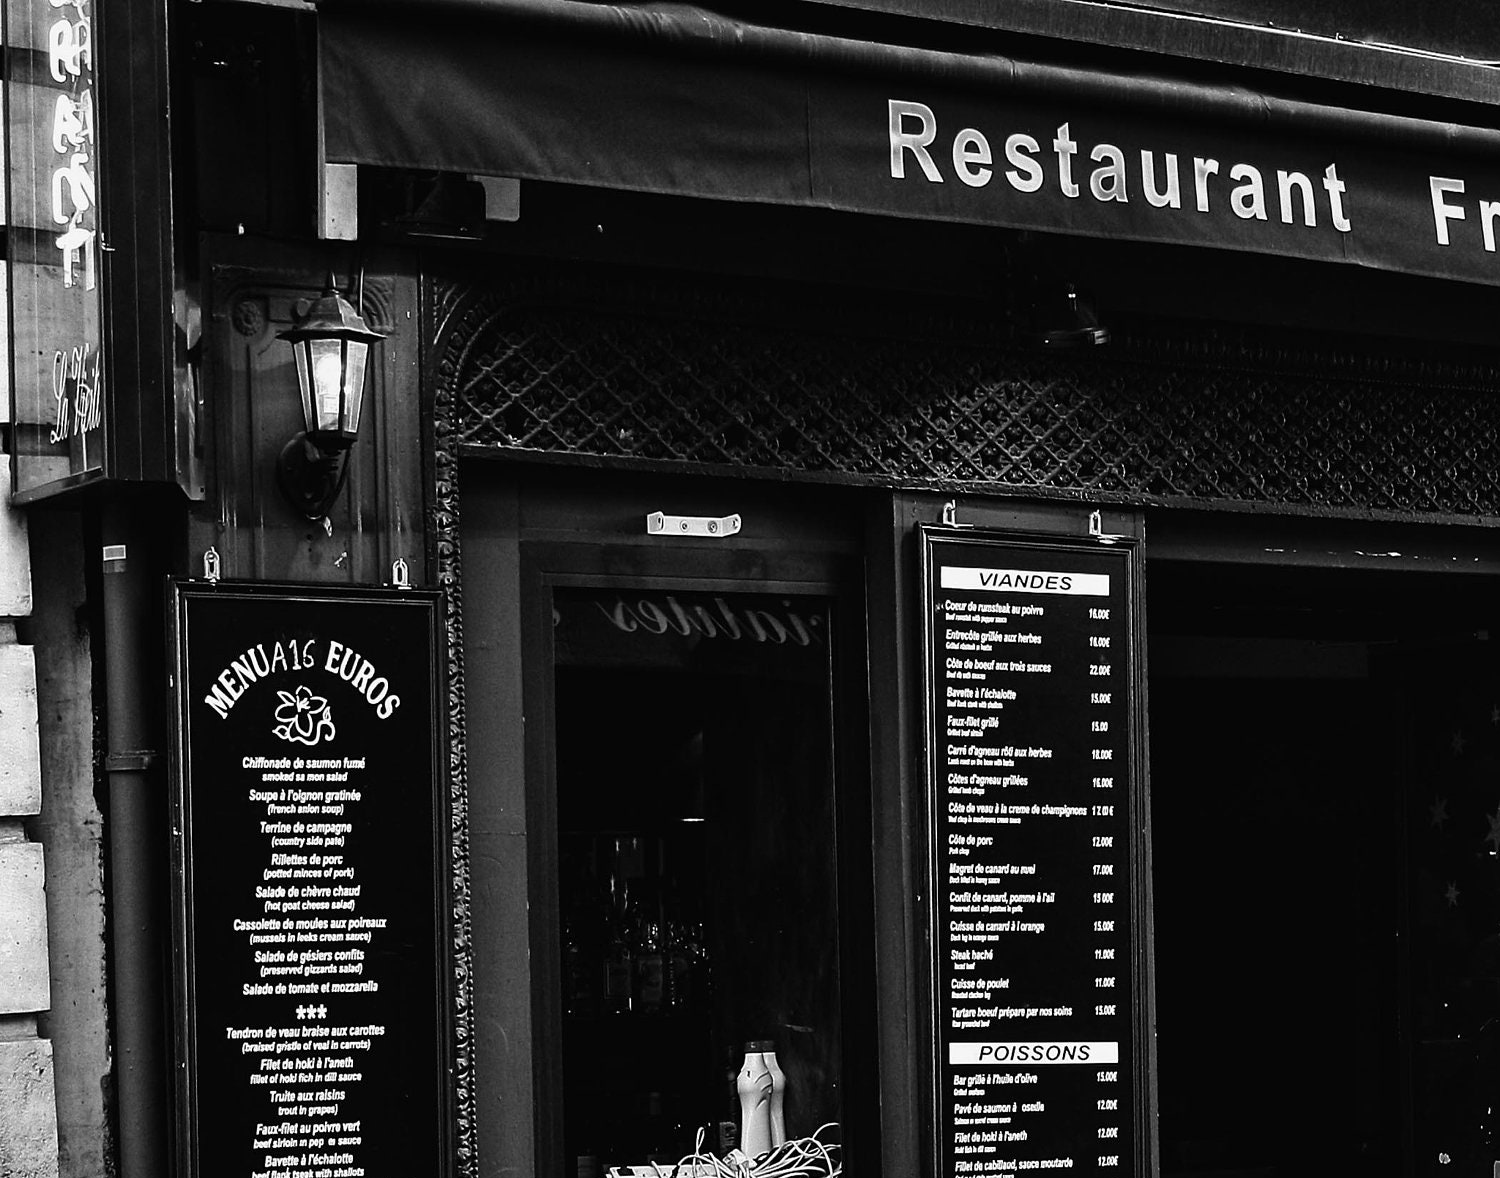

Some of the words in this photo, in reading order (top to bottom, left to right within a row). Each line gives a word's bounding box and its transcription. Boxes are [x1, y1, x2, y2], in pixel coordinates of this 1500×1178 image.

[887, 99, 1351, 232] Restaurant
[979, 572, 1073, 591] VIANDES
[204, 644, 271, 719] MENU
[325, 641, 401, 719] EUROS
[974, 687, 979, 699] à
[242, 756, 291, 769] Chiffonade
[292, 756, 304, 769] de
[305, 759, 341, 769] saumon
[343, 756, 365, 769] fumé
[248, 789, 278, 803] Soupe
[279, 788, 285, 801] à
[287, 790, 323, 804] l'oignon
[324, 789, 361, 804] gratinée
[259, 821, 291, 834] Terrine
[292, 821, 305, 834] de
[306, 823, 351, 836] campagne
[271, 853, 307, 866] Rillettes
[309, 853, 321, 865] de
[321, 855, 343, 868] porc
[255, 885, 285, 898] Salade
[287, 885, 299, 898] de
[300, 884, 331, 897] chèvre
[332, 884, 360, 897] chaud
[233, 918, 280, 931] Cassolette
[282, 917, 294, 930] de
[295, 917, 328, 930] moules
[329, 919, 347, 929] aux
[347, 917, 387, 930] poireaux
[254, 950, 285, 963] Salade
[286, 949, 298, 962] de
[299, 950, 332, 964] gésiers
[333, 949, 364, 963] confits
[242, 982, 273, 995] Salade
[274, 982, 286, 995] de
[288, 982, 319, 995] tomate
[320, 981, 330, 994] et
[331, 980, 378, 993] mozzarella
[976, 978, 985, 990] de
[226, 1026, 263, 1039] Tendron
[264, 1026, 277, 1039] de
[278, 1028, 300, 1038] veau
[330, 1026, 347, 1037] aux
[979, 1045, 1091, 1061] POISSONS
[260, 1058, 280, 1071] Filet
[281, 1058, 293, 1070] de
[295, 1057, 315, 1070] hoki
[316, 1056, 322, 1069] à
[323, 1056, 353, 1069] l'aneth
[269, 1089, 295, 1102] Truite
[296, 1092, 313, 1102] aux
[314, 1088, 345, 1101] raisins
[255, 1122, 298, 1135] Faux-filet
[299, 1124, 311, 1134] au
[312, 1122, 340, 1136] poivre
[342, 1120, 360, 1132] vert
[264, 1155, 299, 1168] Bavette
[300, 1153, 306, 1166] à
